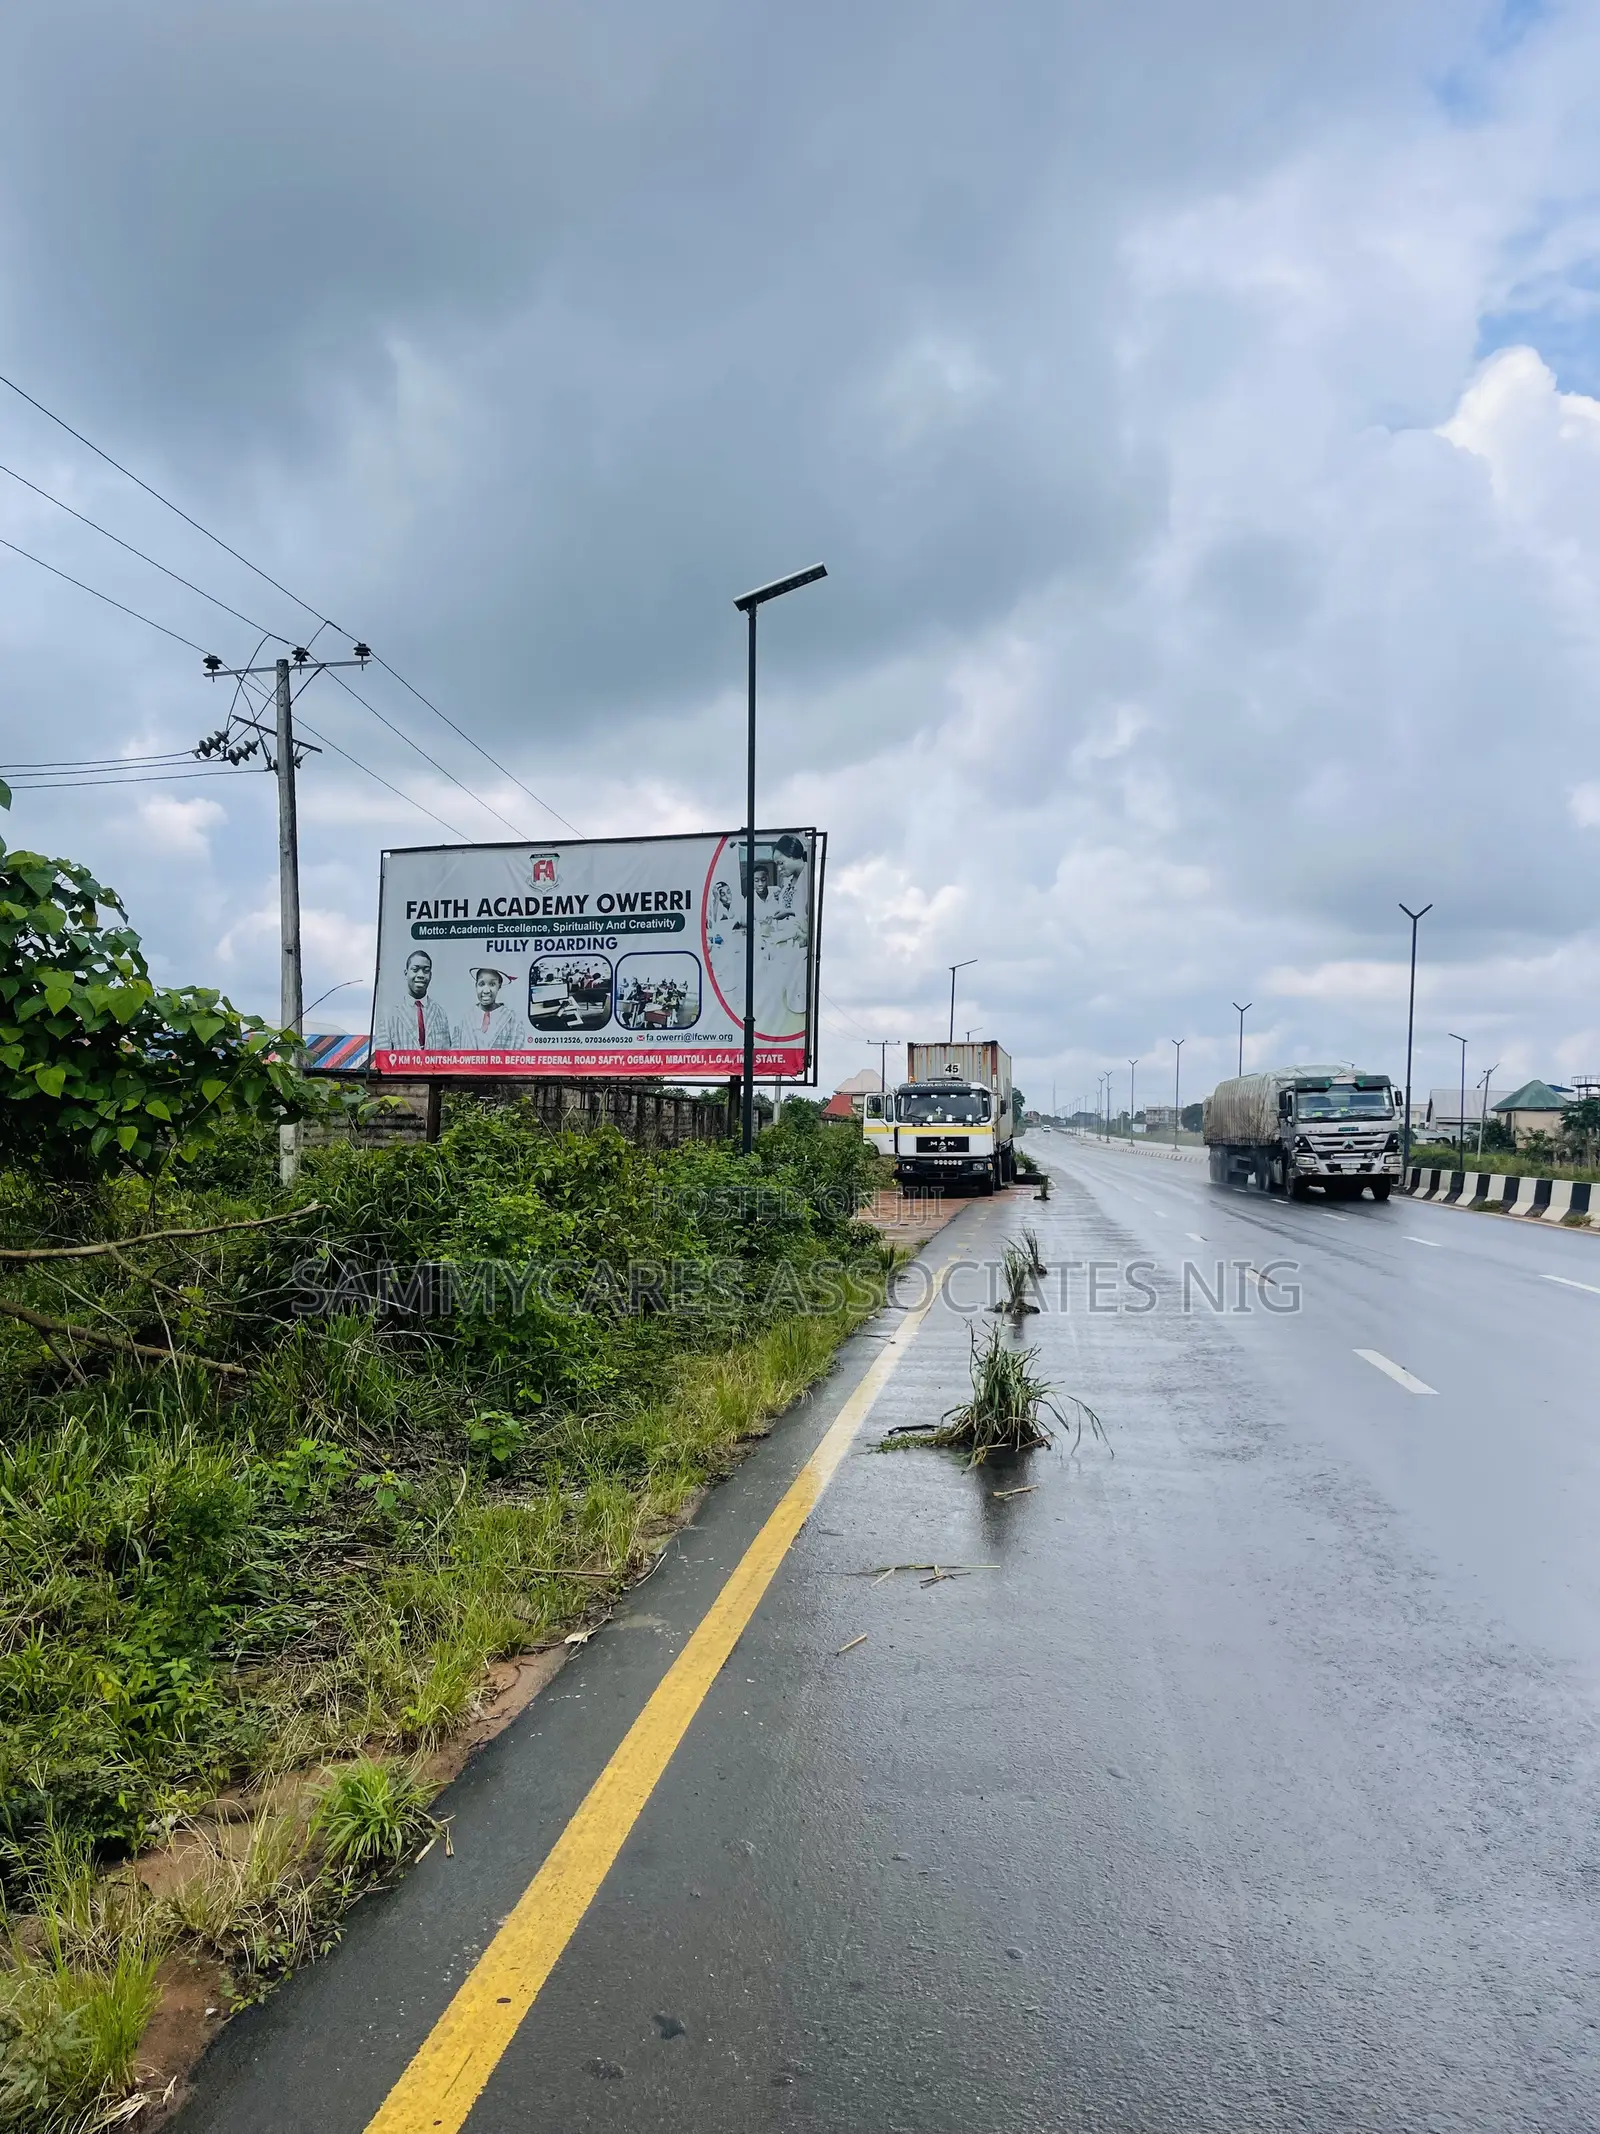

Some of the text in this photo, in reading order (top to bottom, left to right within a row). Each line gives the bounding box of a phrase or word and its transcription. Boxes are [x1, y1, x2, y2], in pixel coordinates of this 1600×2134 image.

[406, 889, 692, 919] FAITH ACADEMY OWERRI
[419, 918, 676, 936] Motto: Academic Excellence, Spirituality And Creativity
[486, 936, 618, 953] FULLY BOARDING
[398, 1055, 410, 1065] KM
[411, 1055, 423, 1067] 10,
[425, 1055, 488, 1065] ONITSHA-OWERRI
[490, 1055, 503, 1065] RD.
[504, 1055, 536, 1065] BEFORE
[537, 1055, 573, 1065] FEDERAL
[574, 1055, 596, 1065] ROAD
[598, 1055, 625, 1066] SAFTY,
[626, 1054, 664, 1066] OGBAKU,
[665, 1054, 707, 1066] MBAITOLI,
[755, 1054, 786, 1064] STATE.
[944, 1063, 960, 1075] 45
